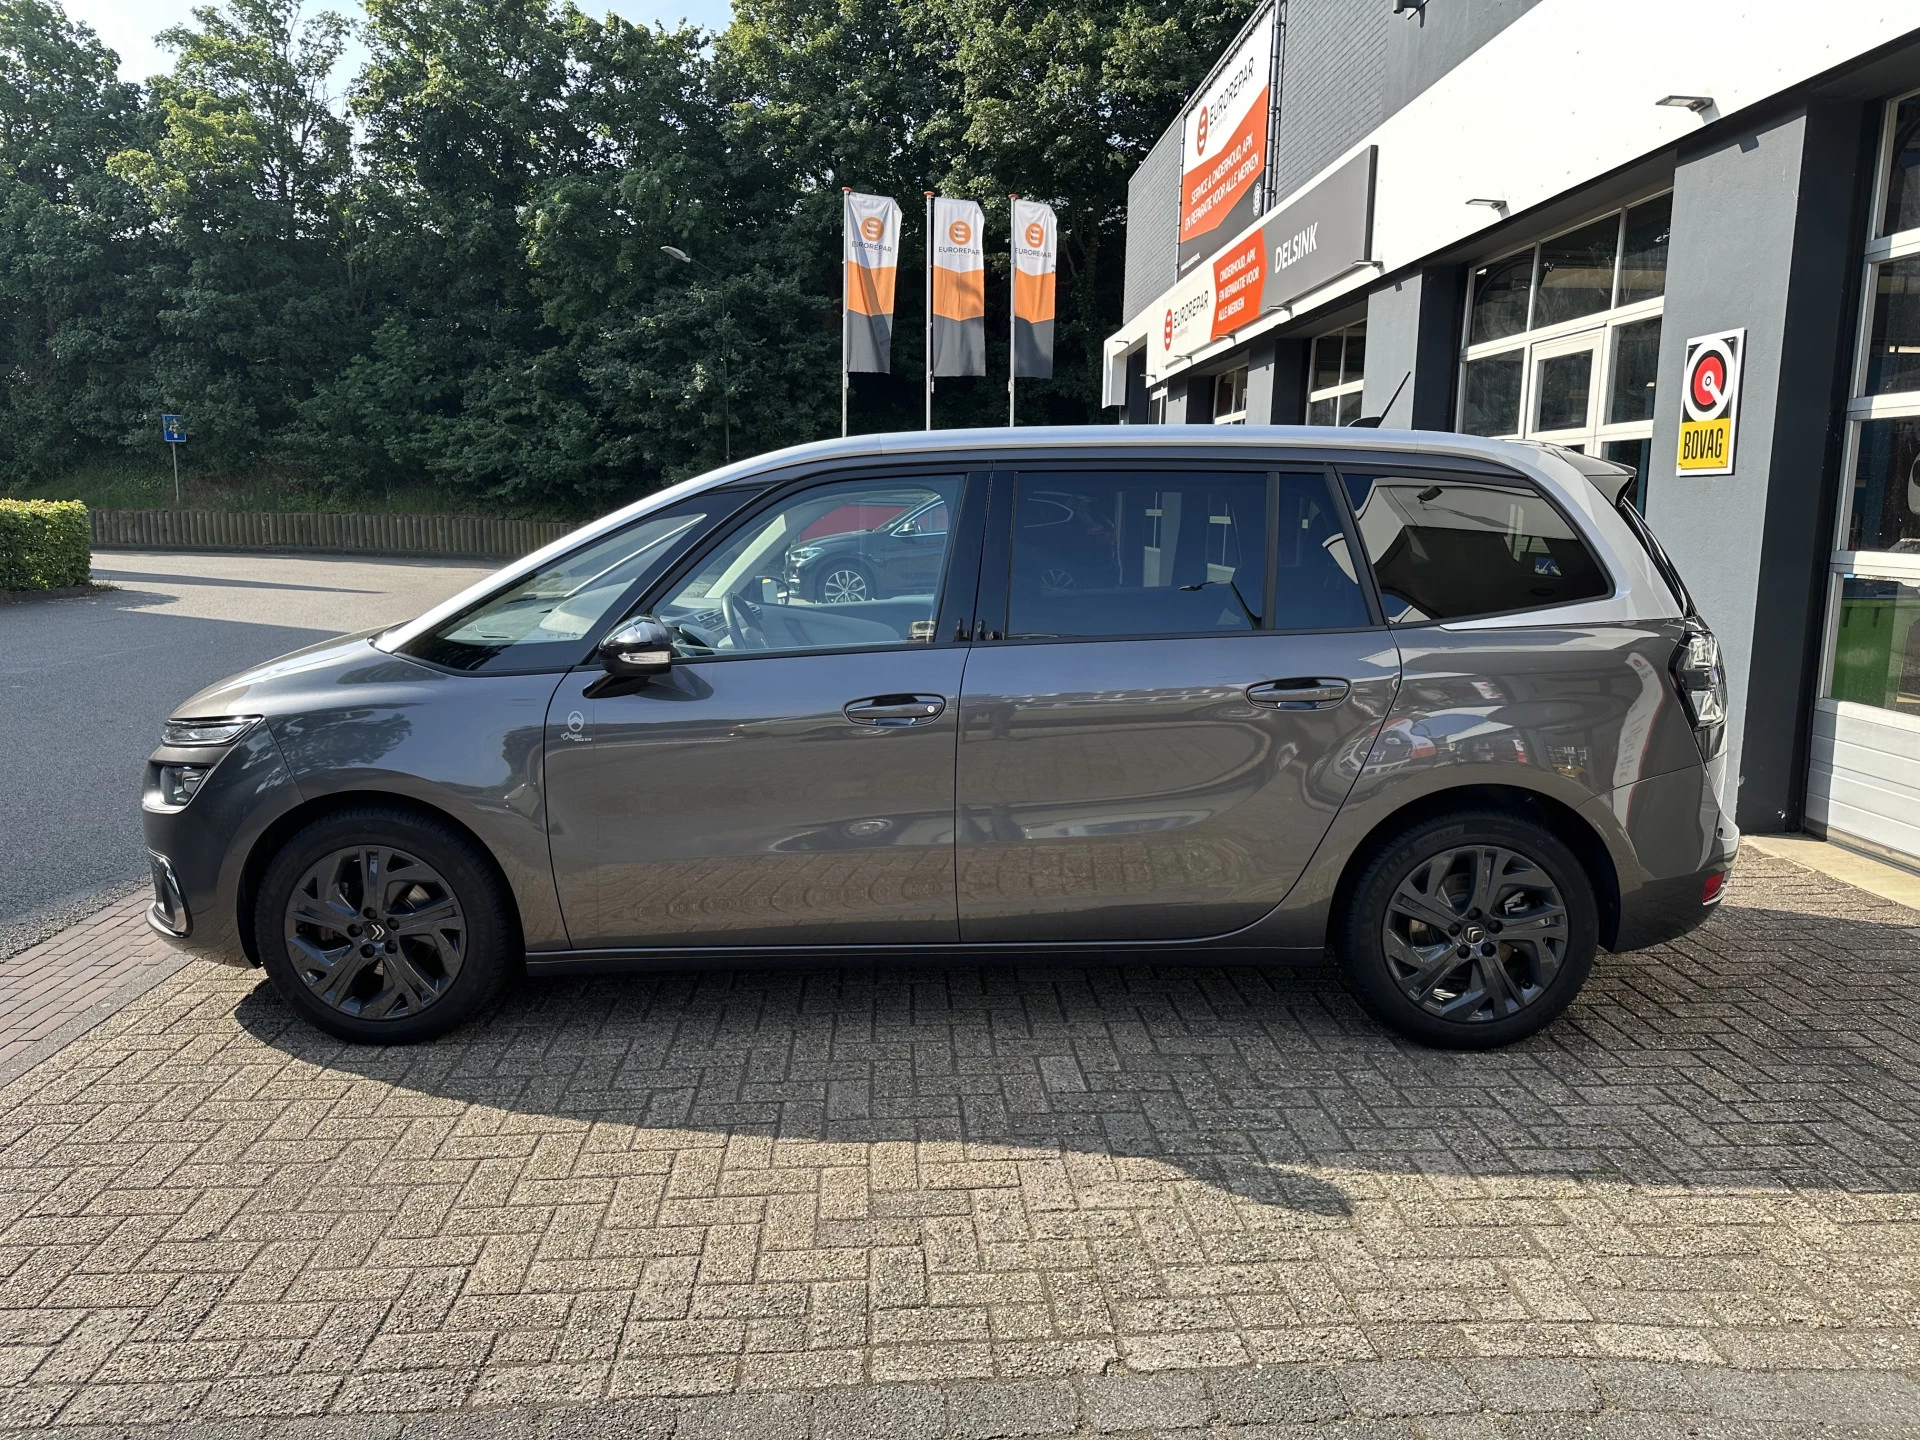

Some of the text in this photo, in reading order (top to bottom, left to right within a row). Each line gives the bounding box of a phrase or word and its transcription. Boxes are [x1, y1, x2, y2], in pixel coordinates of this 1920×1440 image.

[1210, 57, 1254, 125] EUROREPAR
[1191, 183, 1208, 205] SERVICE
[1242, 131, 1253, 154] APK
[1185, 151, 1259, 231] EN REPARATIE VOOR ALLE MERKEN
[938, 246, 980, 256] EUROREPAR
[1246, 247, 1256, 263] APK
[1274, 221, 1318, 274] DELSINK
[1218, 266, 1260, 303] EN REPARATIE VOOR
[1174, 290, 1209, 329] EUROREPAR
[1218, 296, 1245, 322] ALLE MERKEN
[1683, 428, 1723, 460] BOVAG
